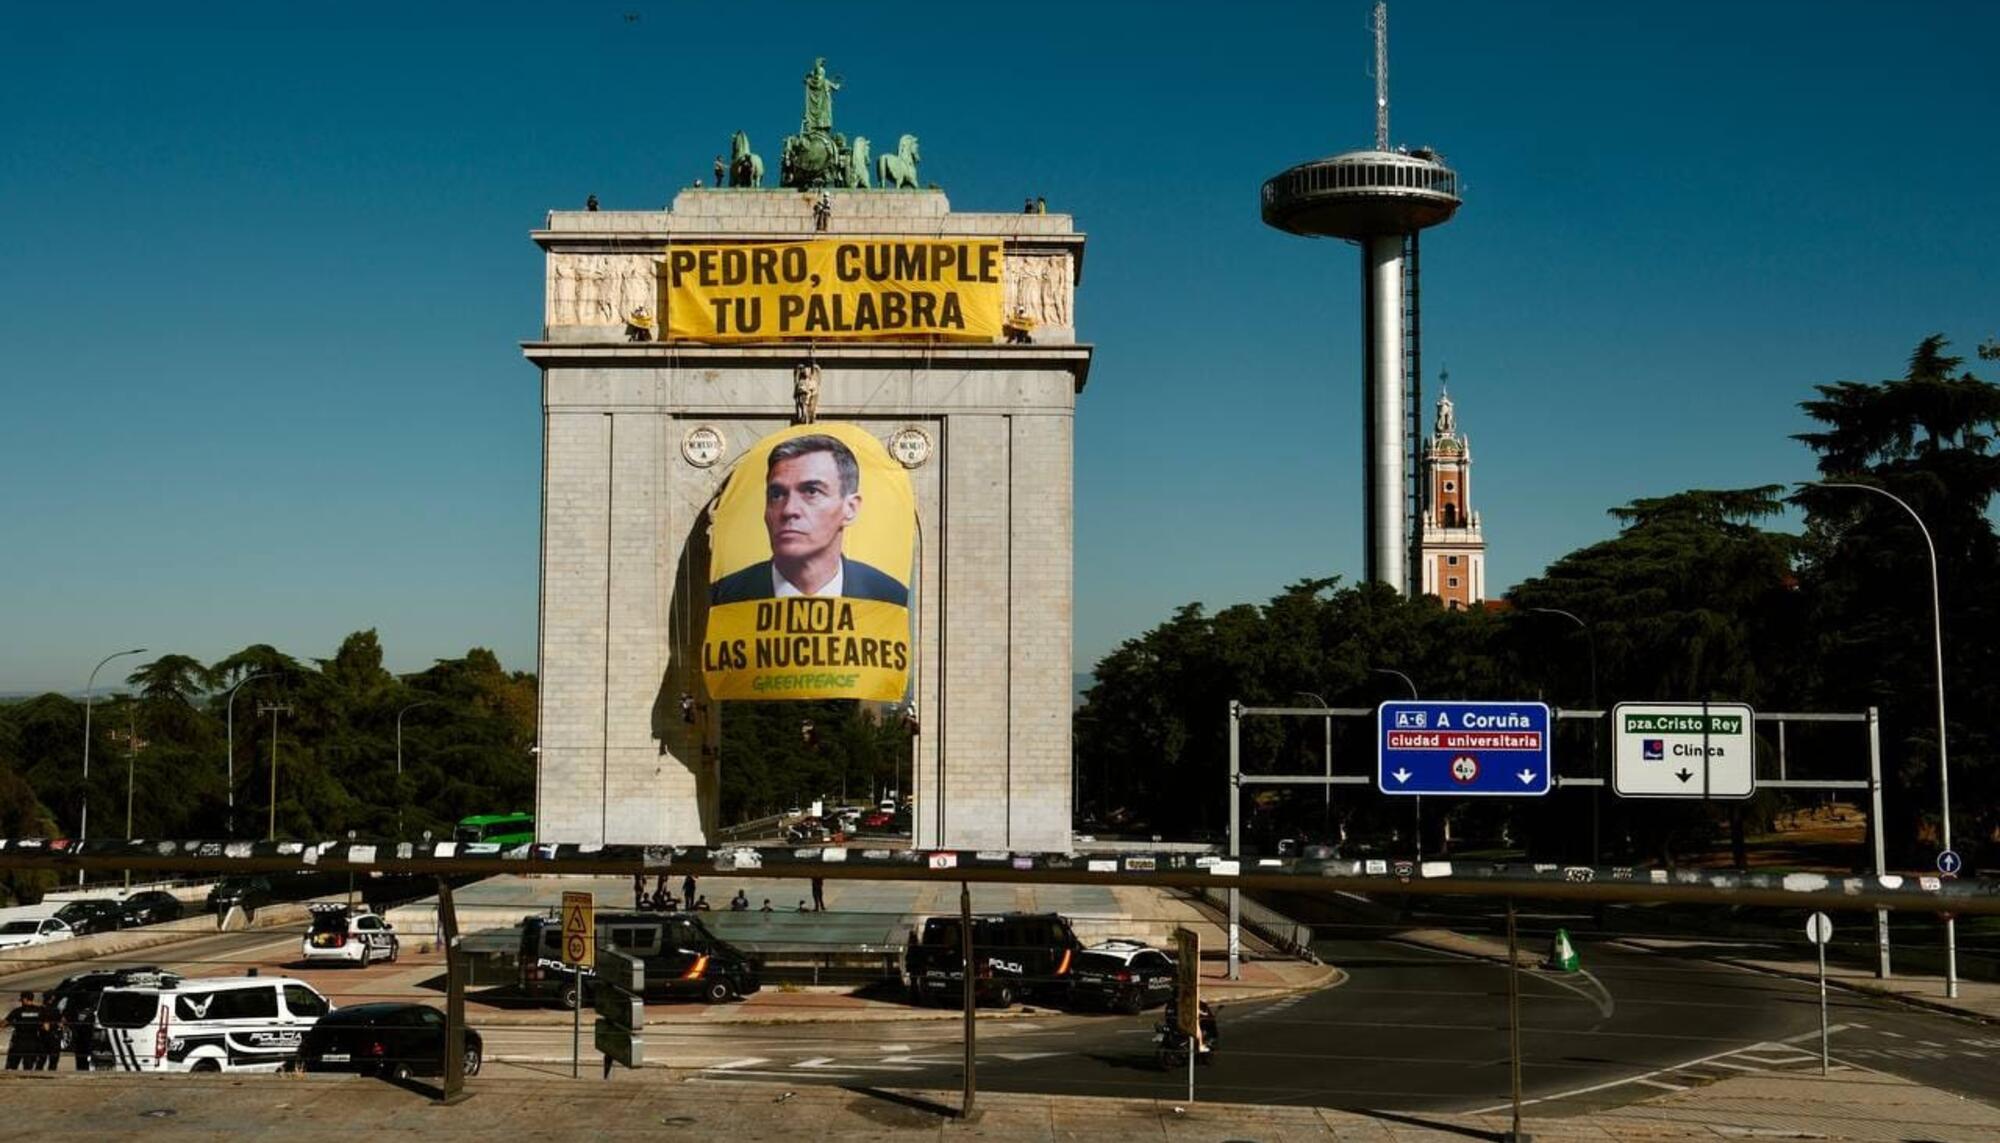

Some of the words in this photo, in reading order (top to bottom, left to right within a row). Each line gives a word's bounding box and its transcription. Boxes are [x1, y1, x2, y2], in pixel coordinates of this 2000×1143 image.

[671, 246, 821, 288] PEDRO,
[835, 244, 999, 284] CUMPLE
[709, 296, 762, 334] TU
[778, 291, 966, 333] PALABRA
[756, 602, 782, 632] DI
[791, 600, 830, 632] NO
[837, 602, 855, 631] A
[703, 639, 748, 672] LAS
[756, 637, 908, 671] NUCLEARES
[752, 673, 861, 692] GREENPEACE
[1398, 714, 1425, 726] A-6
[1437, 712, 1450, 728] A
[1462, 712, 1530, 728] Coruña
[1627, 717, 1703, 731] pza.Cristo
[1711, 719, 1740, 733] Rey
[1391, 734, 1439, 747] ciudad
[1447, 735, 1538, 747] universitaria
[1672, 743, 1725, 757] Clínca
